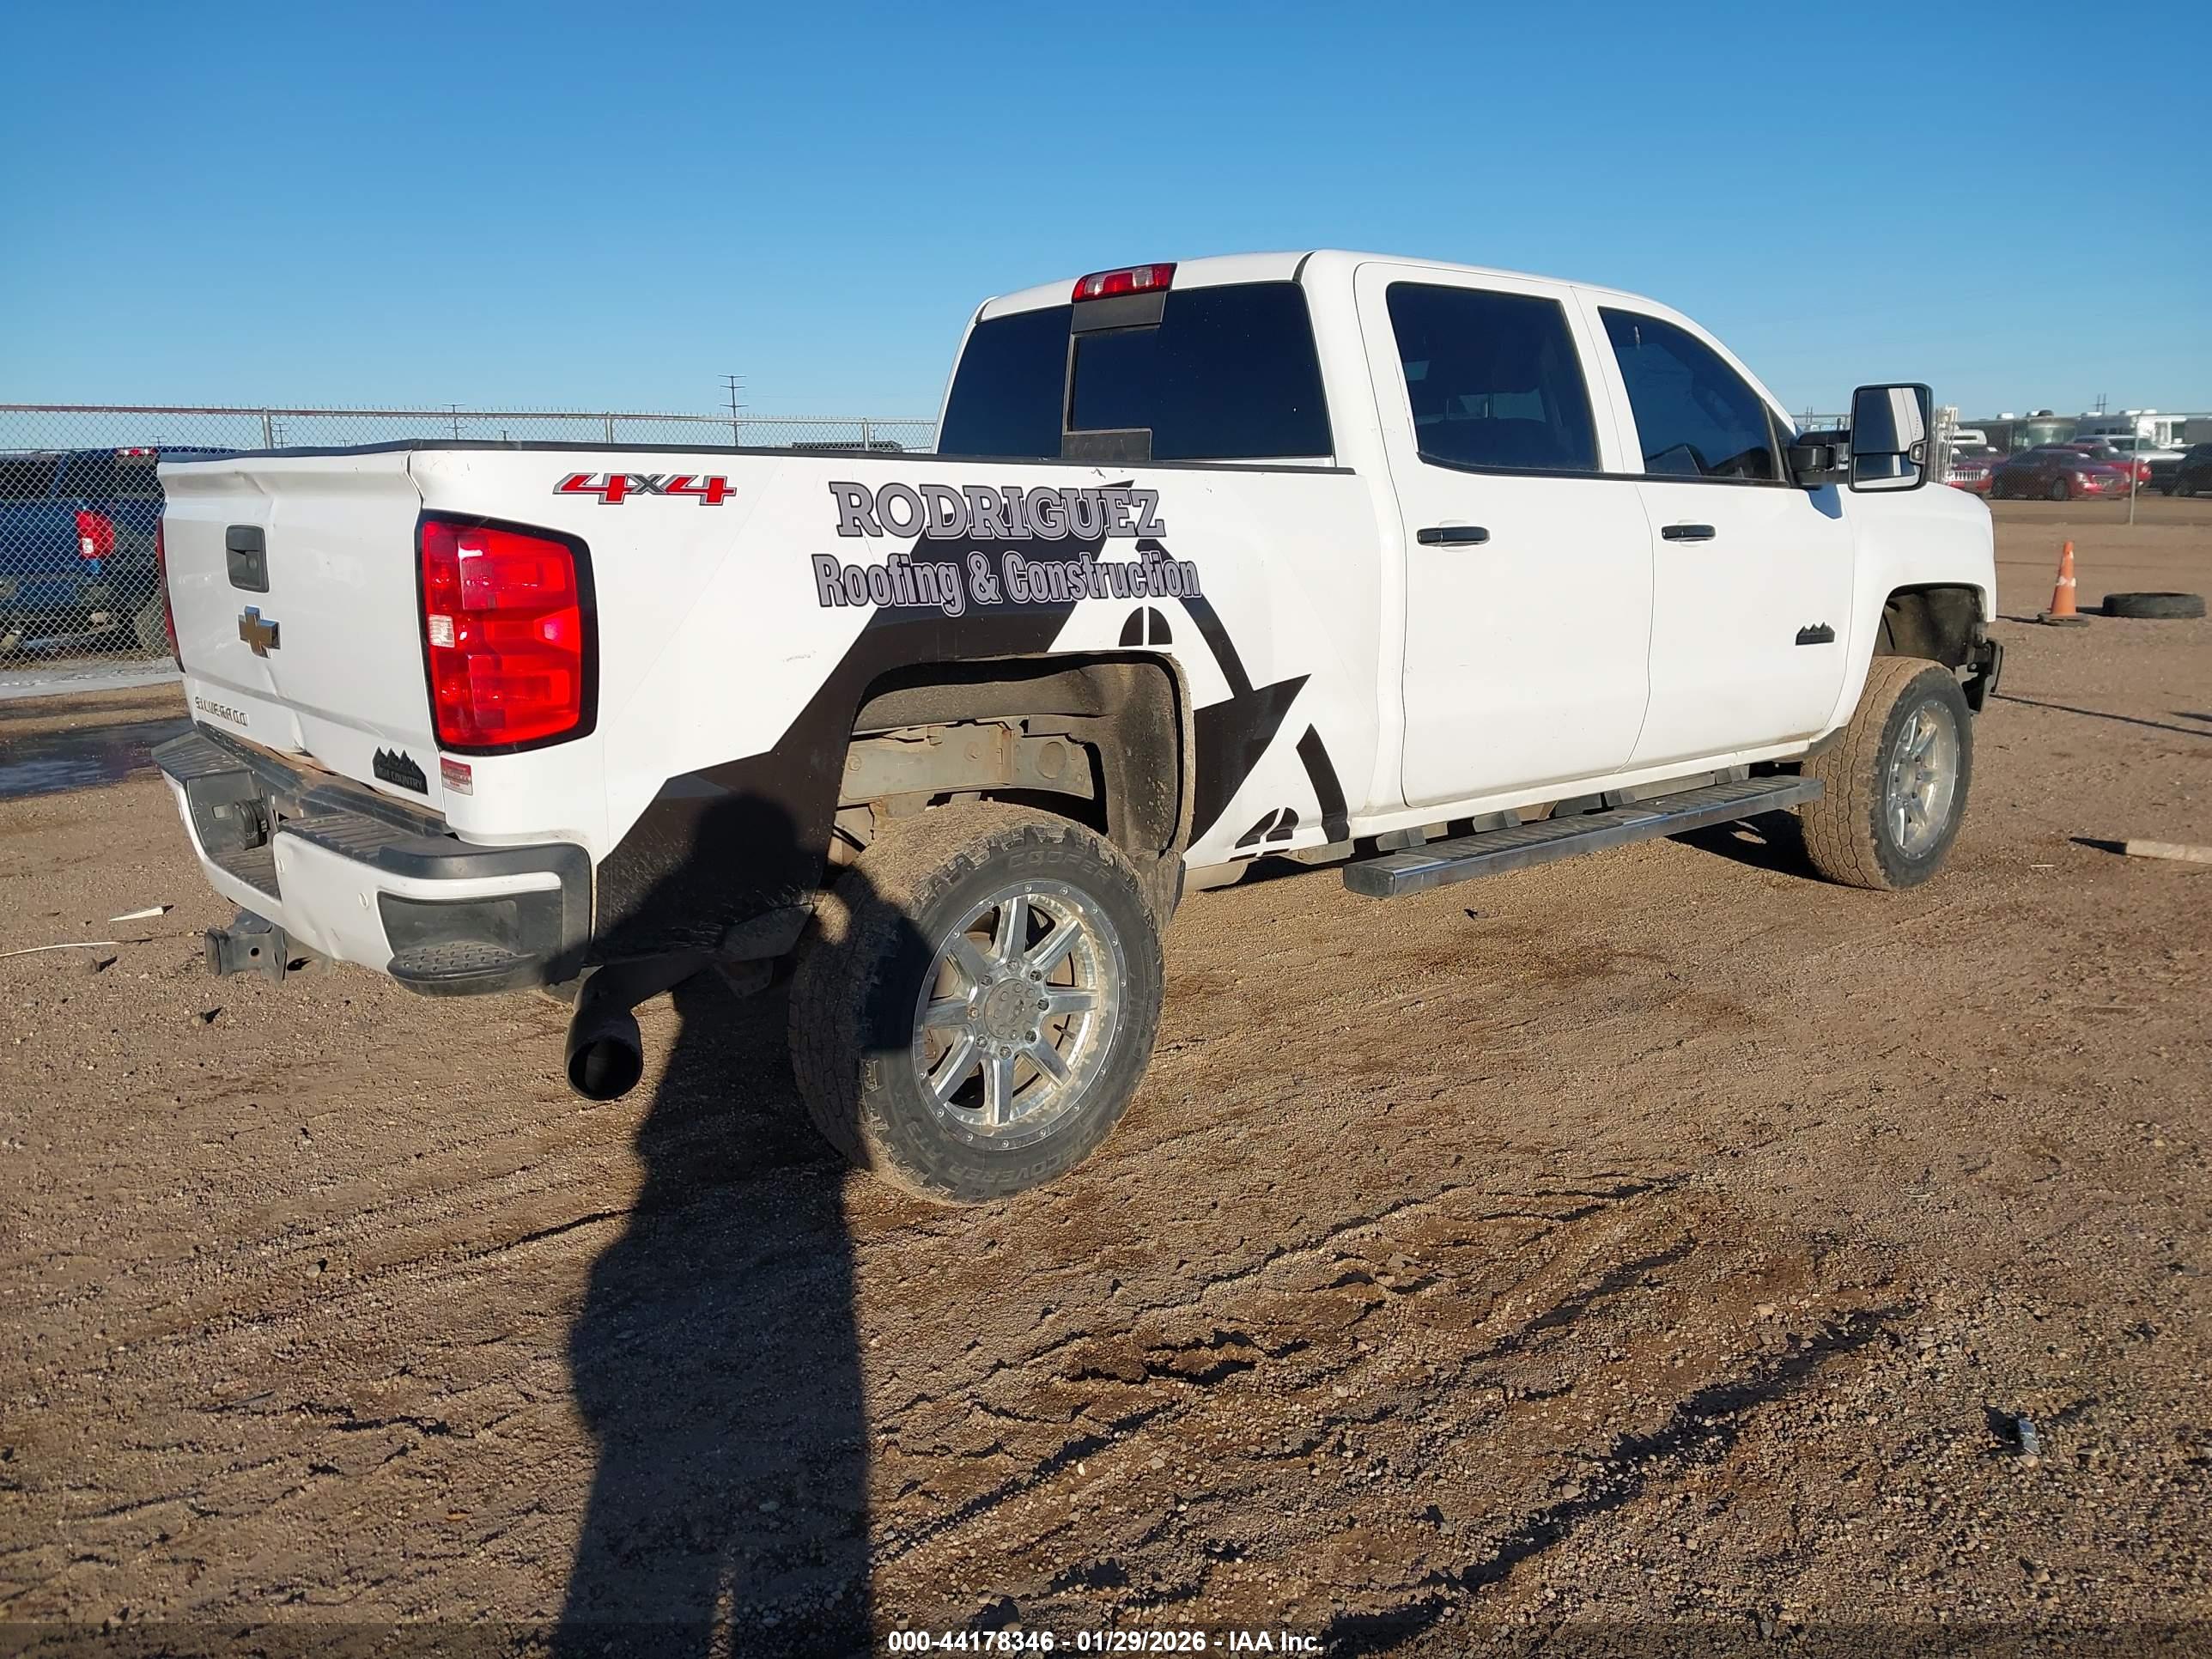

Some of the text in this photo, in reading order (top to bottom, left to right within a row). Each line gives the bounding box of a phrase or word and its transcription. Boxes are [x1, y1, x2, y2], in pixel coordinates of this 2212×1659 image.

[829, 481, 1166, 540] RODRIGUEZ
[811, 551, 1201, 617] Roofing & Construction
[195, 696, 248, 726] SILVERADO
